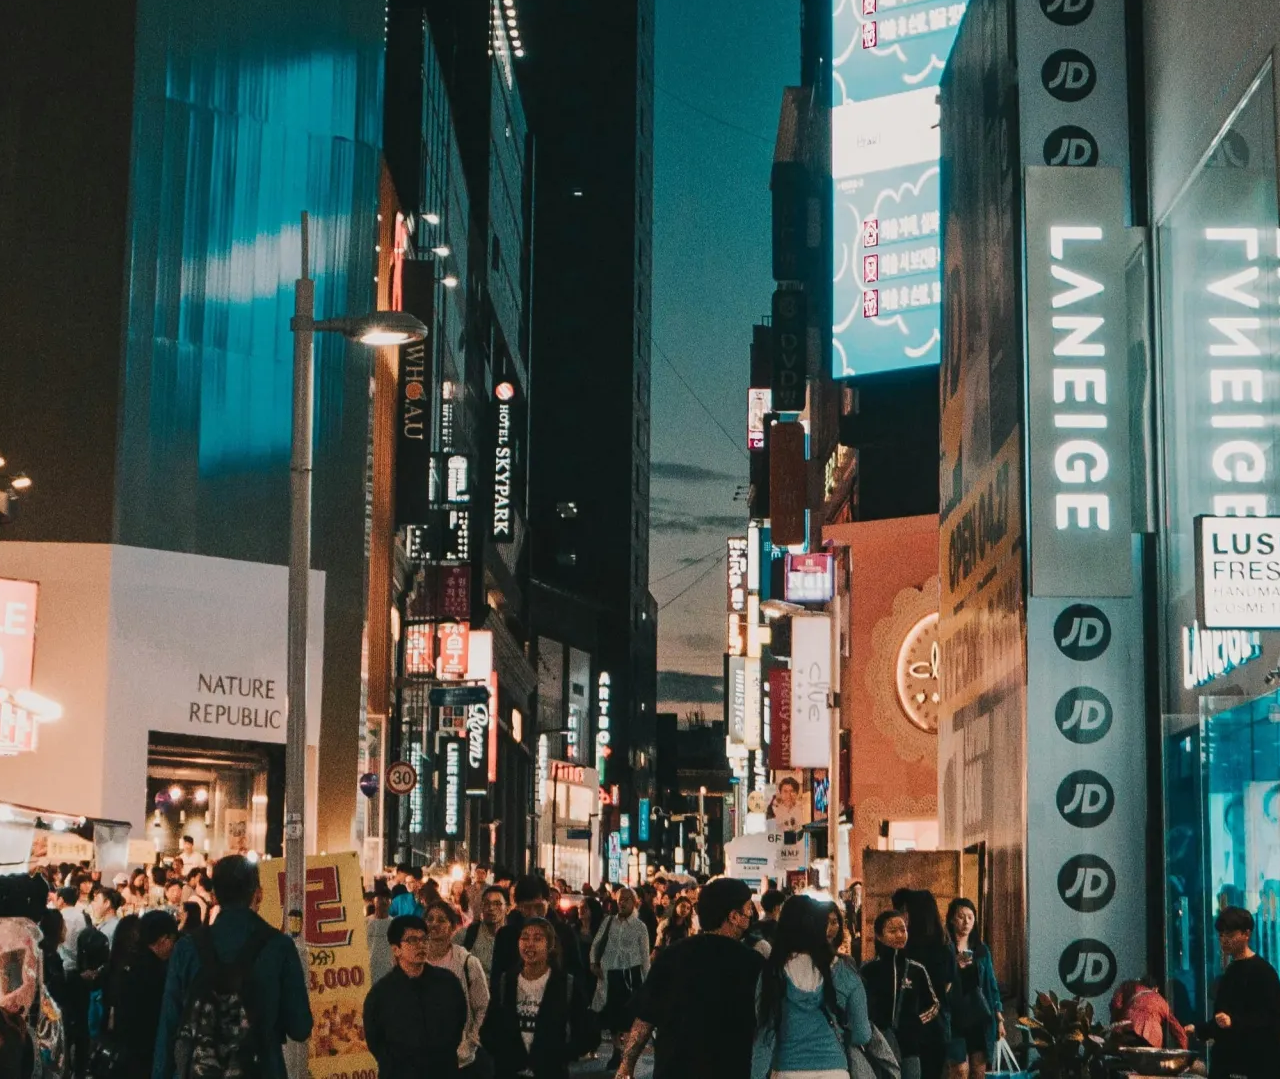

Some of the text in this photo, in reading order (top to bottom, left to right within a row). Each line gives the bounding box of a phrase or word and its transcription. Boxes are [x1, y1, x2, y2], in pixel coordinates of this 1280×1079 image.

[1048, 61, 1090, 89] JD
[1050, 138, 1092, 166] JD
[1049, 226, 1110, 530] LANEIGE
[493, 403, 511, 536] HOTEL SKYPARK
[1061, 617, 1104, 648] JD
[197, 672, 277, 700] NATURE
[189, 702, 282, 730] REPUBLIC
[1063, 699, 1106, 731] JD
[392, 770, 410, 786] 30
[1064, 783, 1108, 814] JD
[1065, 867, 1109, 898] JD
[1066, 951, 1111, 983] JD
